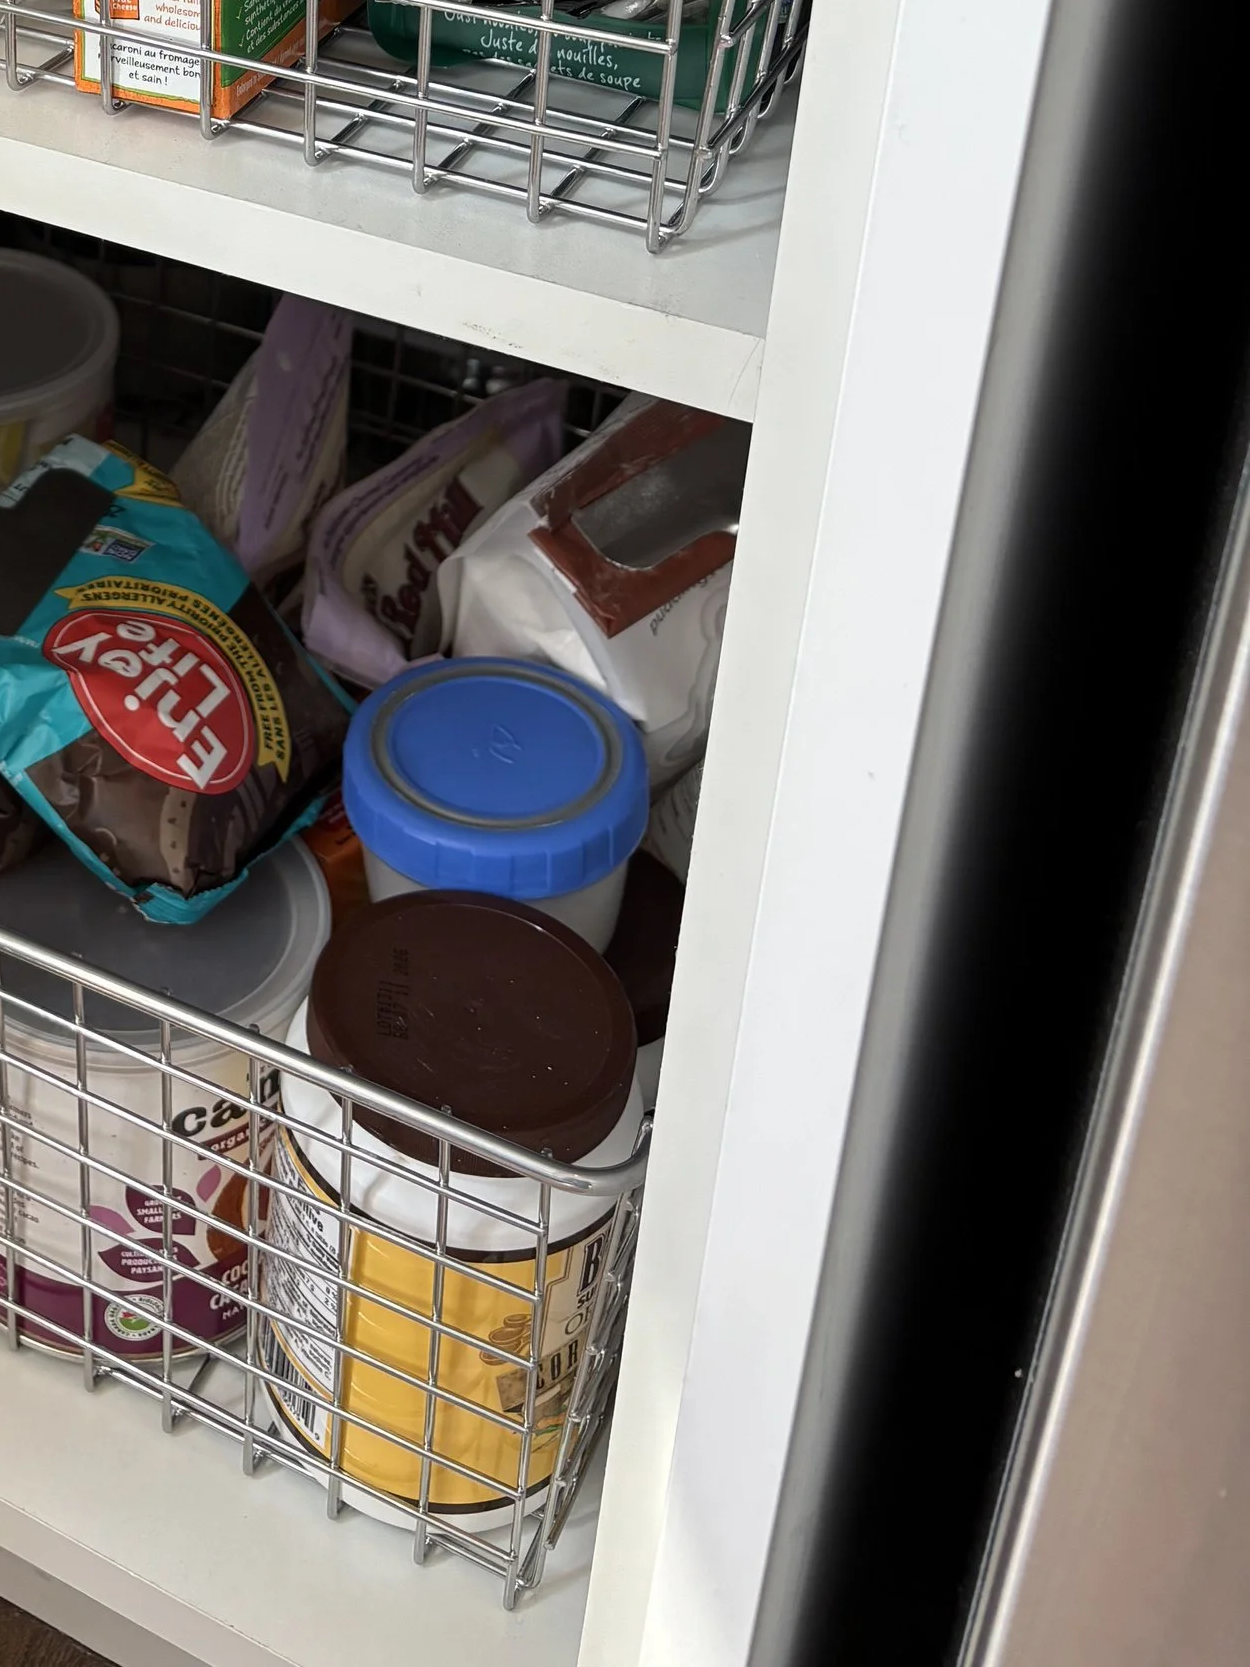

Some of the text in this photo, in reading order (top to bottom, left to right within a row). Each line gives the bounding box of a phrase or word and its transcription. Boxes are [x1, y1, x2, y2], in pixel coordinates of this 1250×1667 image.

[144, 14, 162, 24] and
[144, 48, 200, 68] au fromage
[480, 29, 523, 50] Juste
[557, 45, 618, 71] nouilles,
[128, 70, 162, 84] et sain
[600, 72, 642, 92] soupe
[116, 620, 231, 718] Life
[52, 632, 228, 790] Enjoy
[273, 716, 286, 761] SANS
